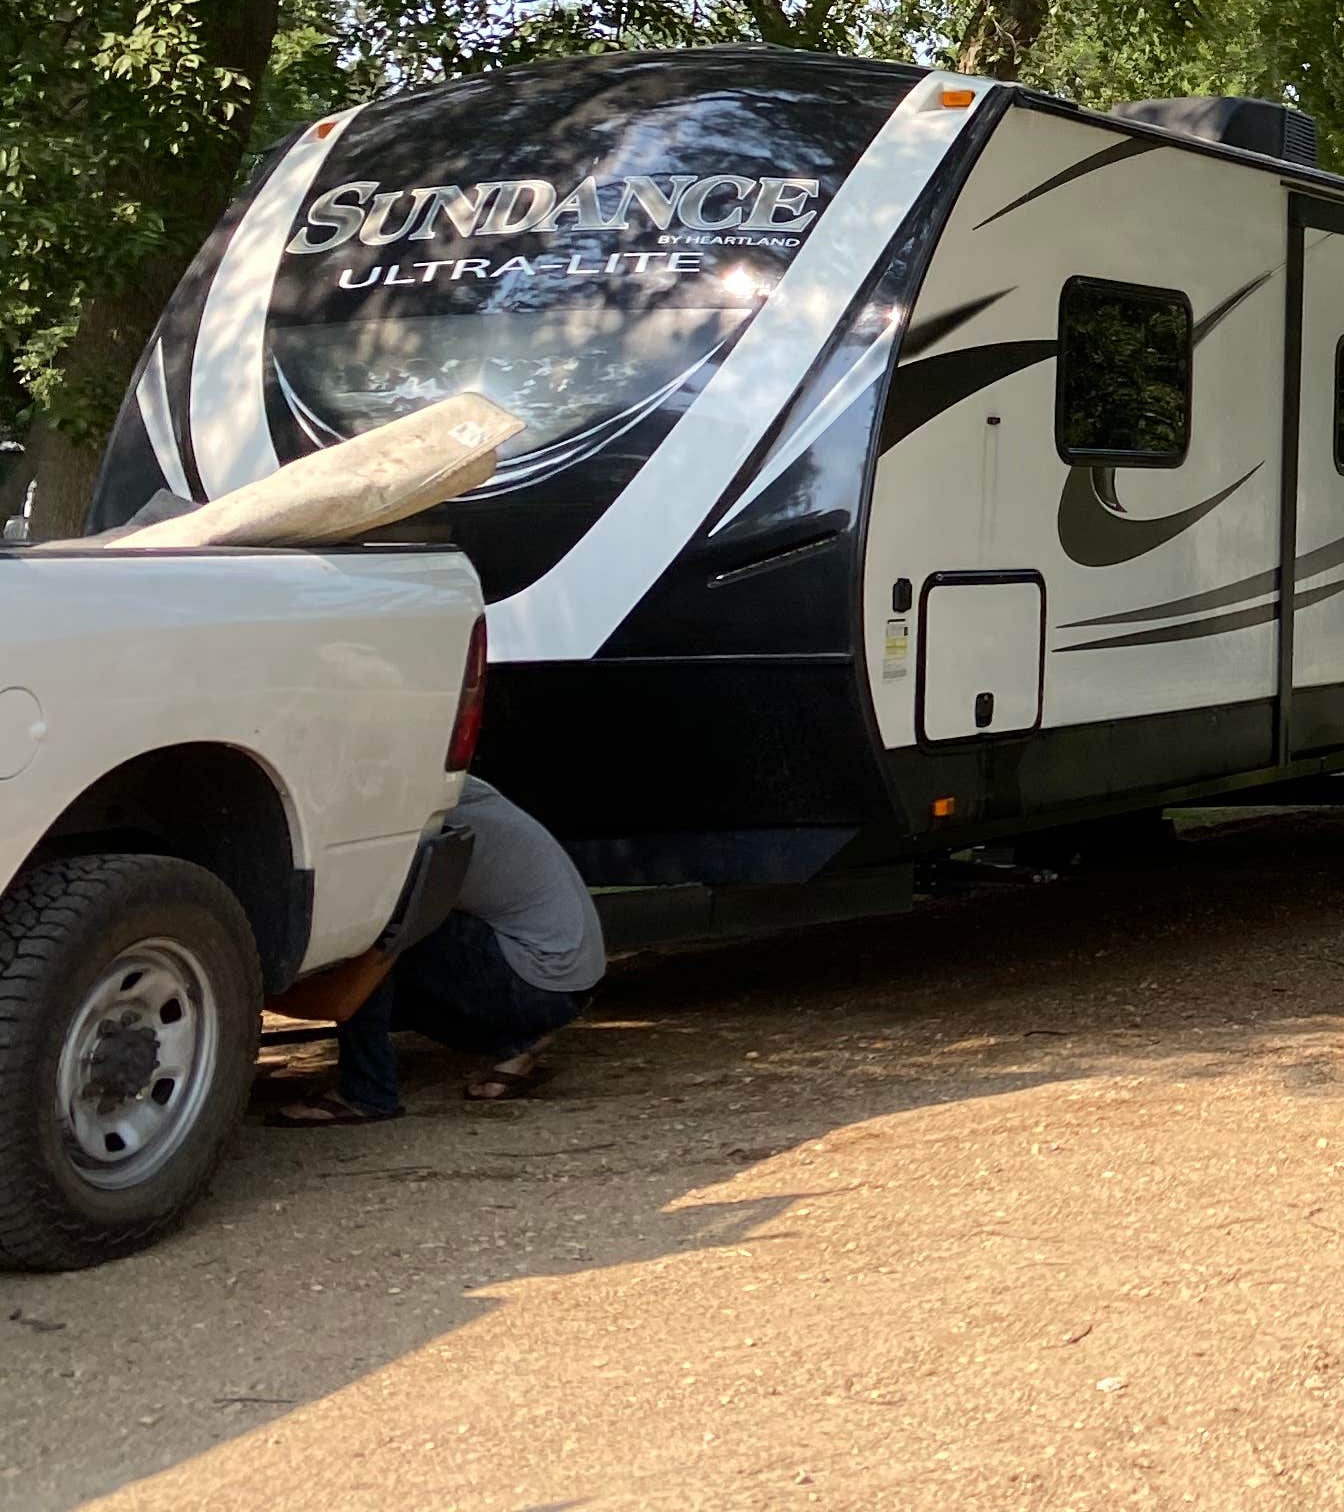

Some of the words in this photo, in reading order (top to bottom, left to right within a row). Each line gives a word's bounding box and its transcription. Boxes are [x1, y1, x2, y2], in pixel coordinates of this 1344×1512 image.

[285, 174, 820, 255] SUNDANCE
[657, 235, 682, 245] BY
[685, 236, 801, 248] HEARTLAND
[338, 252, 704, 289] ULTRA-LITE
